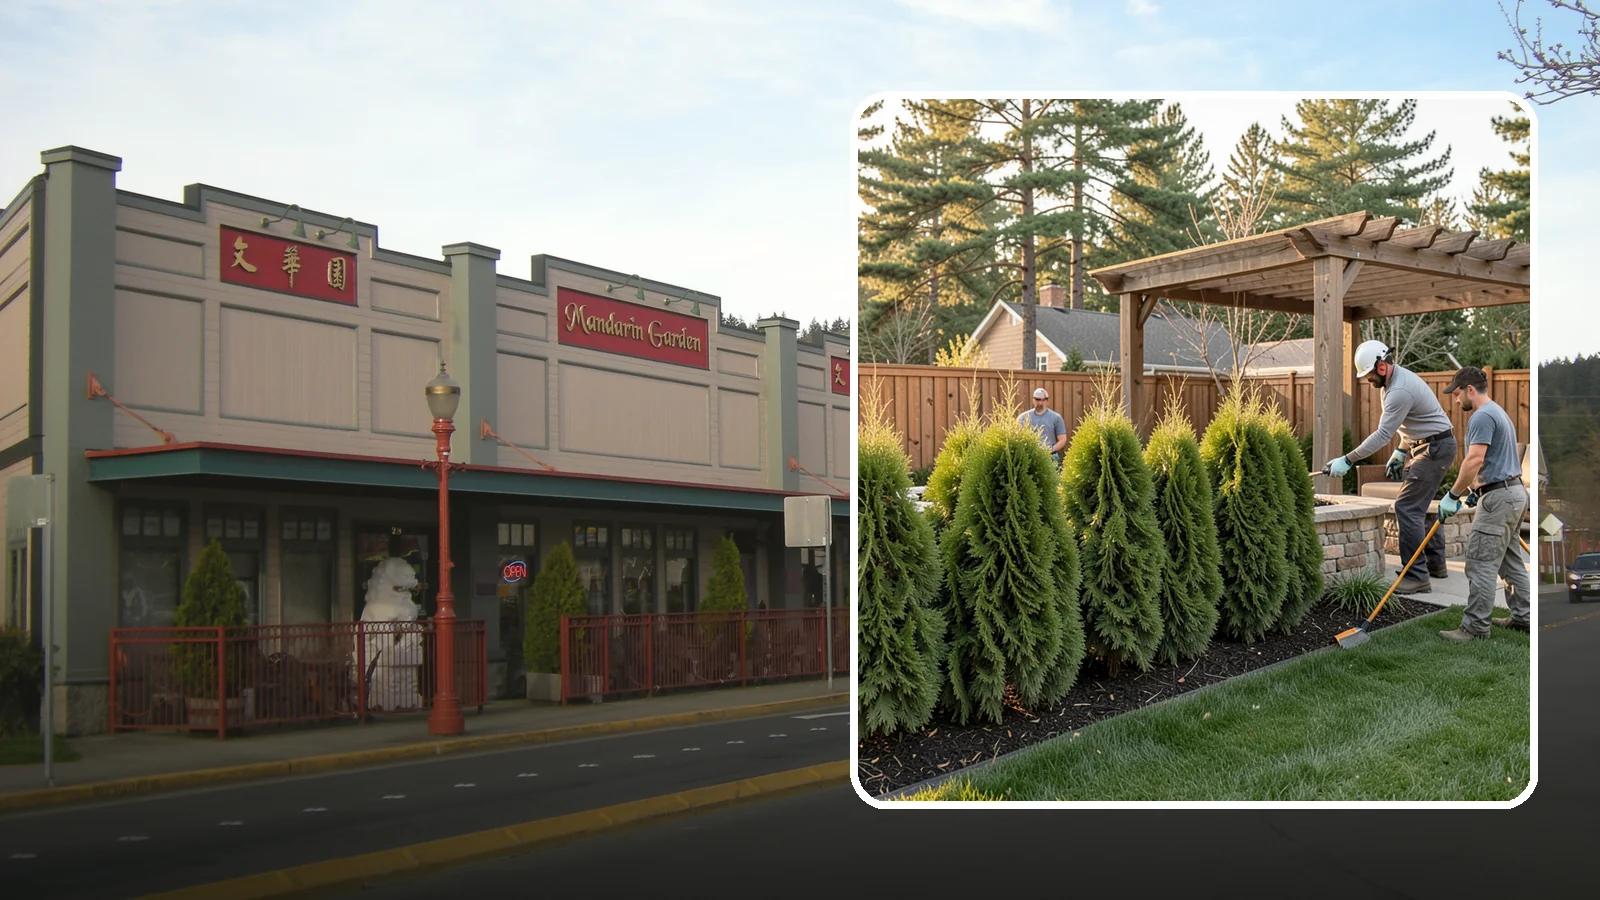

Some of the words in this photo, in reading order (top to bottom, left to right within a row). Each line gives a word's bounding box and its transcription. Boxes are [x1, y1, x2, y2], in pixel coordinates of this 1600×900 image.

[230, 236, 346, 291] 文華園
[564, 301, 644, 341] Mandarin
[647, 320, 702, 353] Garden
[503, 565, 527, 578] OPEN
